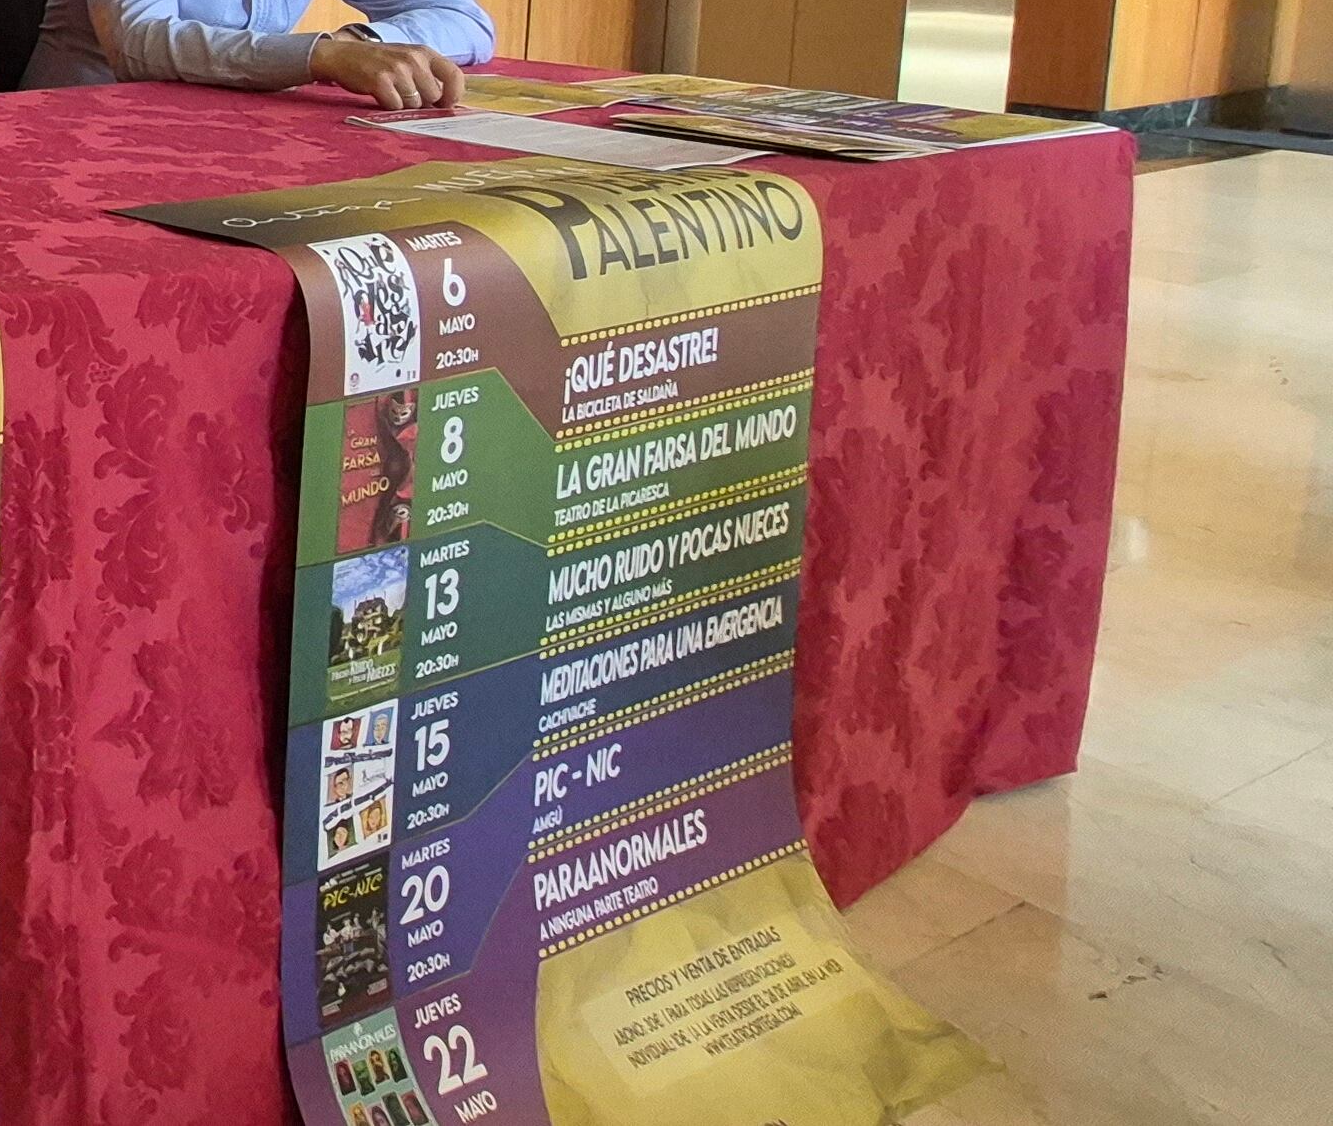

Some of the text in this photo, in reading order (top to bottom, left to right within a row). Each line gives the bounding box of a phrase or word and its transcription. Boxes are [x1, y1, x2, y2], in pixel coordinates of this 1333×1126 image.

[406, 231, 462, 253] MARTES
[463, 180, 805, 280] PALENTINO
[442, 257, 466, 307] 6
[439, 312, 476, 336] MAYO
[435, 347, 479, 371] 20:30H
[563, 327, 719, 405] ¡QUÉ DESASTRE!
[431, 386, 480, 412] JUEVES
[562, 405, 576, 424] LA
[623, 389, 637, 406] DE
[637, 379, 679, 405] SALDAÑA
[349, 435, 378, 450] GRAN
[440, 416, 464, 464] 8
[556, 404, 797, 499] LA GRAN FARSA DEL MUNDO
[342, 451, 381, 473] FARSA
[341, 476, 390, 506] MUNDO
[431, 469, 468, 493] MAYO
[427, 503, 469, 526] 20:30H
[554, 503, 590, 526] TEATRO
[592, 499, 605, 516] DE
[606, 495, 619, 512] LA
[420, 540, 470, 568] MARTES
[548, 502, 790, 604] MUCHO RUIDO Y POCAS NUECES
[424, 568, 460, 620] 13
[421, 621, 458, 647] MAYO
[415, 654, 460, 678] 20:30H
[540, 596, 783, 706] MEDITACIONES PARA UNA EMERGENCIA
[410, 691, 459, 720] JUEVES
[414, 718, 451, 772] 15
[412, 771, 449, 798] MAYO
[534, 742, 622, 806] PIC NIC
[406, 805, 450, 831] 20:30H
[401, 838, 451, 870] MARTES
[534, 808, 708, 911] PARAANORMALES
[399, 864, 451, 925] 20
[540, 876, 659, 941] A NINGUNA PARTE TEATRO
[407, 919, 444, 949] MAYO
[406, 953, 451, 983] 20:30H
[625, 925, 782, 1007] PRECIOS Y VENTA DE ENTRADAS
[414, 992, 462, 1029] JUEVES
[423, 1024, 488, 1096] 22
[453, 1090, 498, 1124] MAYO
